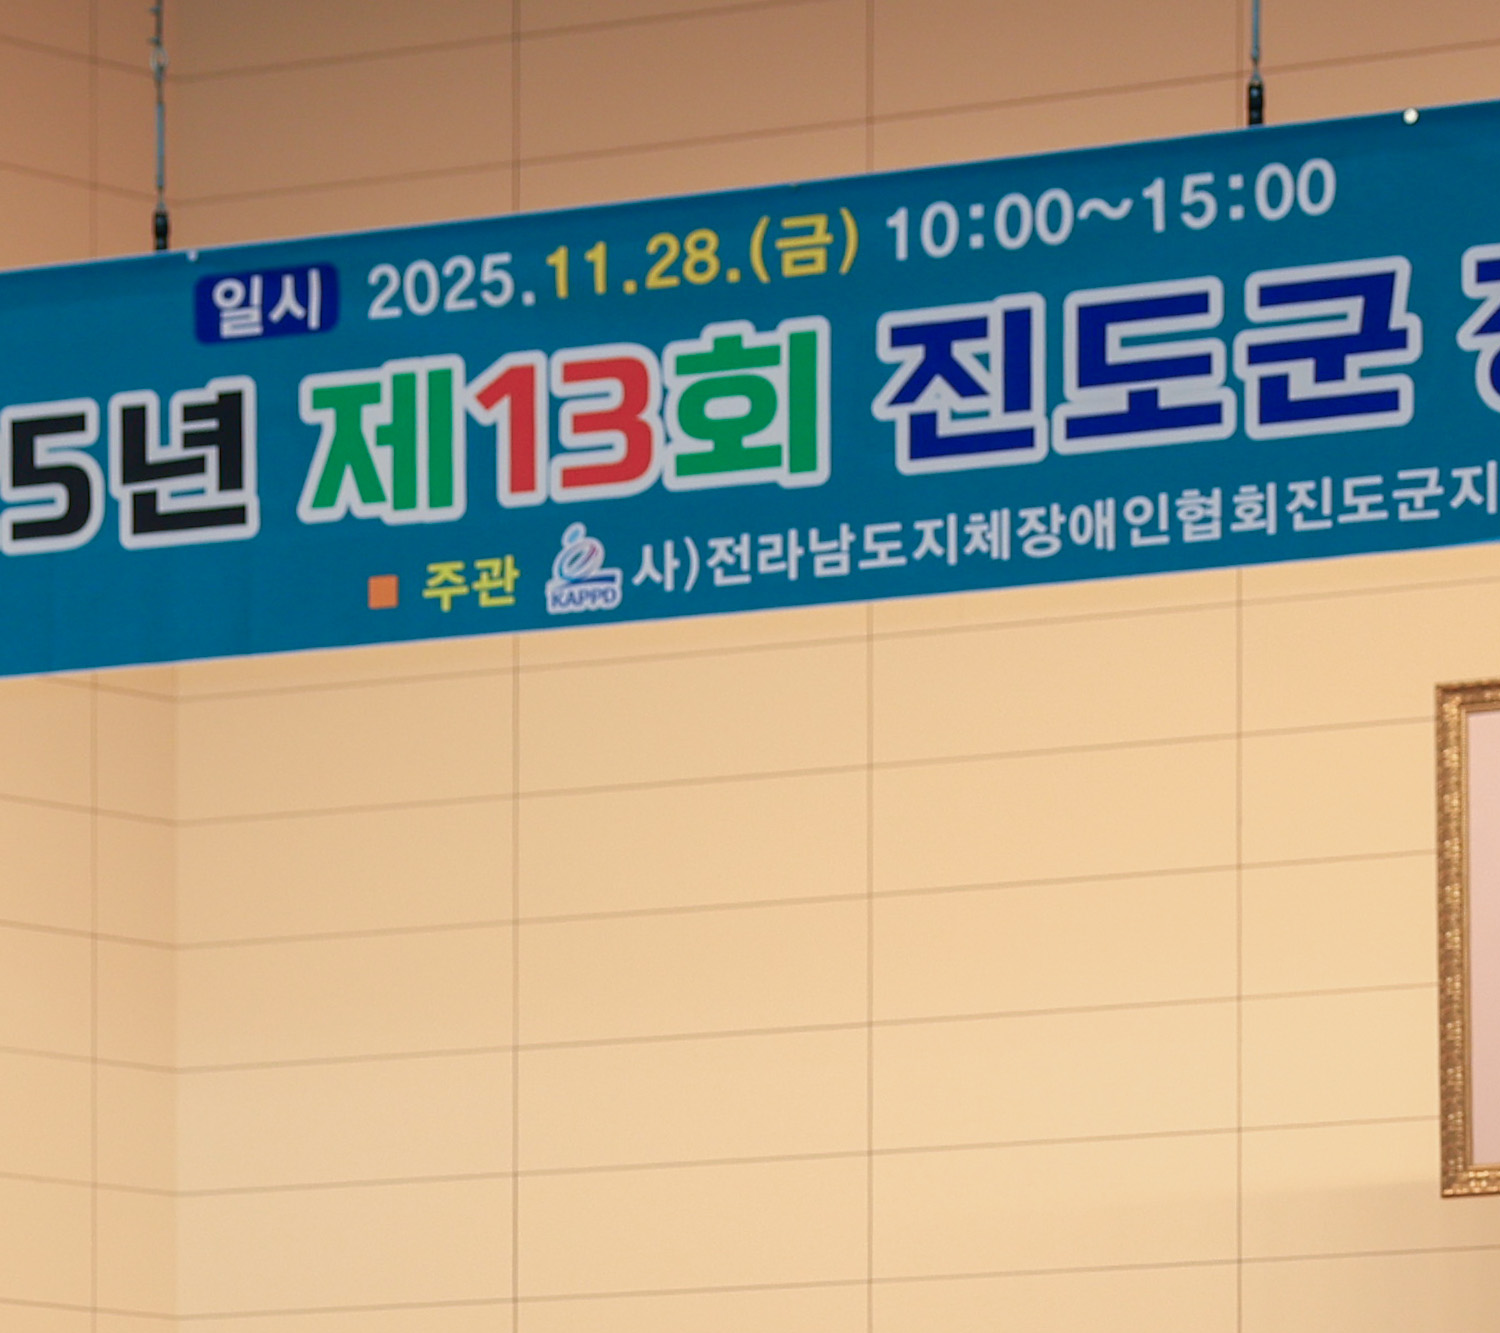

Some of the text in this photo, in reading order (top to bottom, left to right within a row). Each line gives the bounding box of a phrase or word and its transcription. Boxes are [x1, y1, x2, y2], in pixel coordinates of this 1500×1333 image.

[211, 268, 322, 339] 일시
[886, 157, 1337, 261] 10:00~15:00
[302, 317, 828, 523] 제13회
[873, 258, 1419, 473] 진도군
[421, 554, 520, 613] 주관
